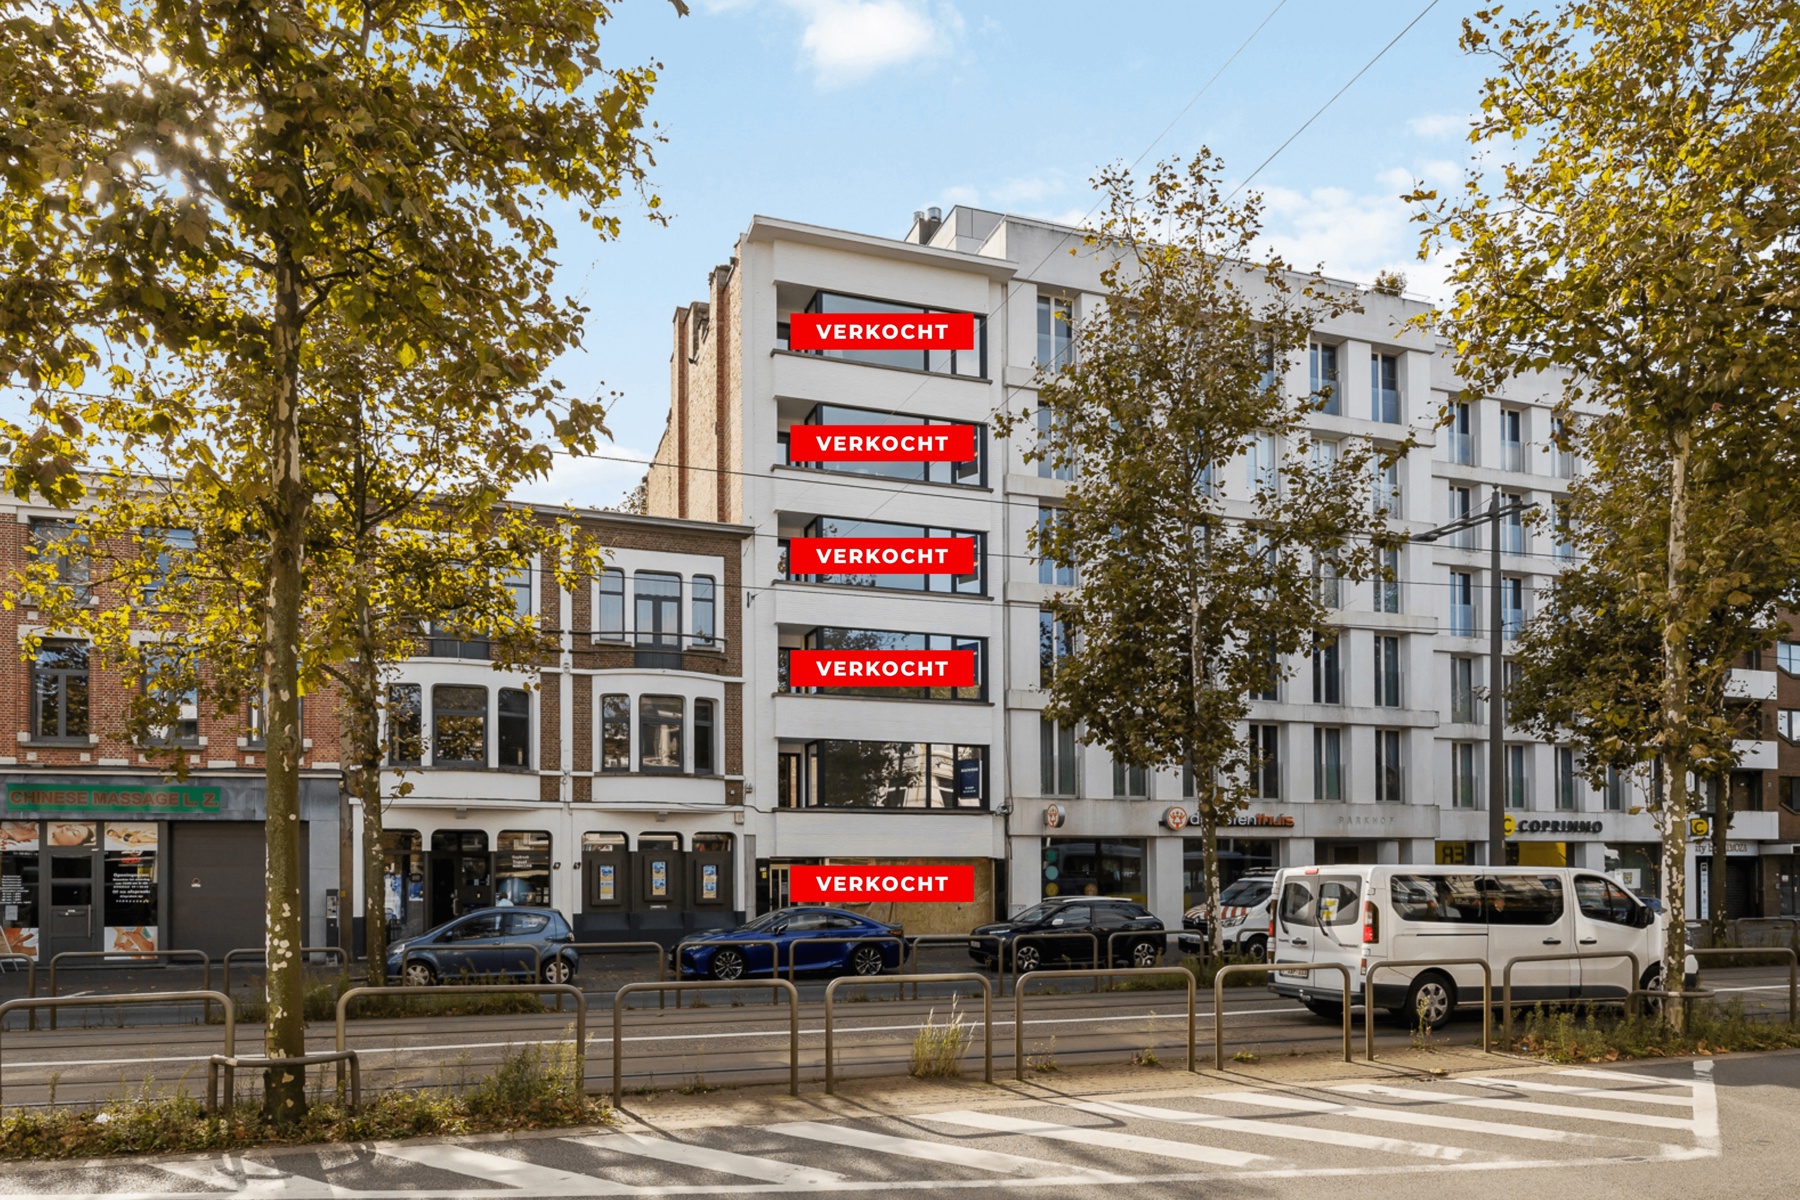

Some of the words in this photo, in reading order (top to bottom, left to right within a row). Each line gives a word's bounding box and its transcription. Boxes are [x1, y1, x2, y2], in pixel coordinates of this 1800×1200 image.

[10, 791, 88, 805] CHINESE
[92, 791, 179, 806] MASSAGE
[183, 792, 198, 806] L.
[203, 792, 218, 806] Z.
[1338, 816, 1394, 824] PARKHOF
[1518, 820, 1603, 833] COPRIMMO
[1694, 821, 1704, 833] C
